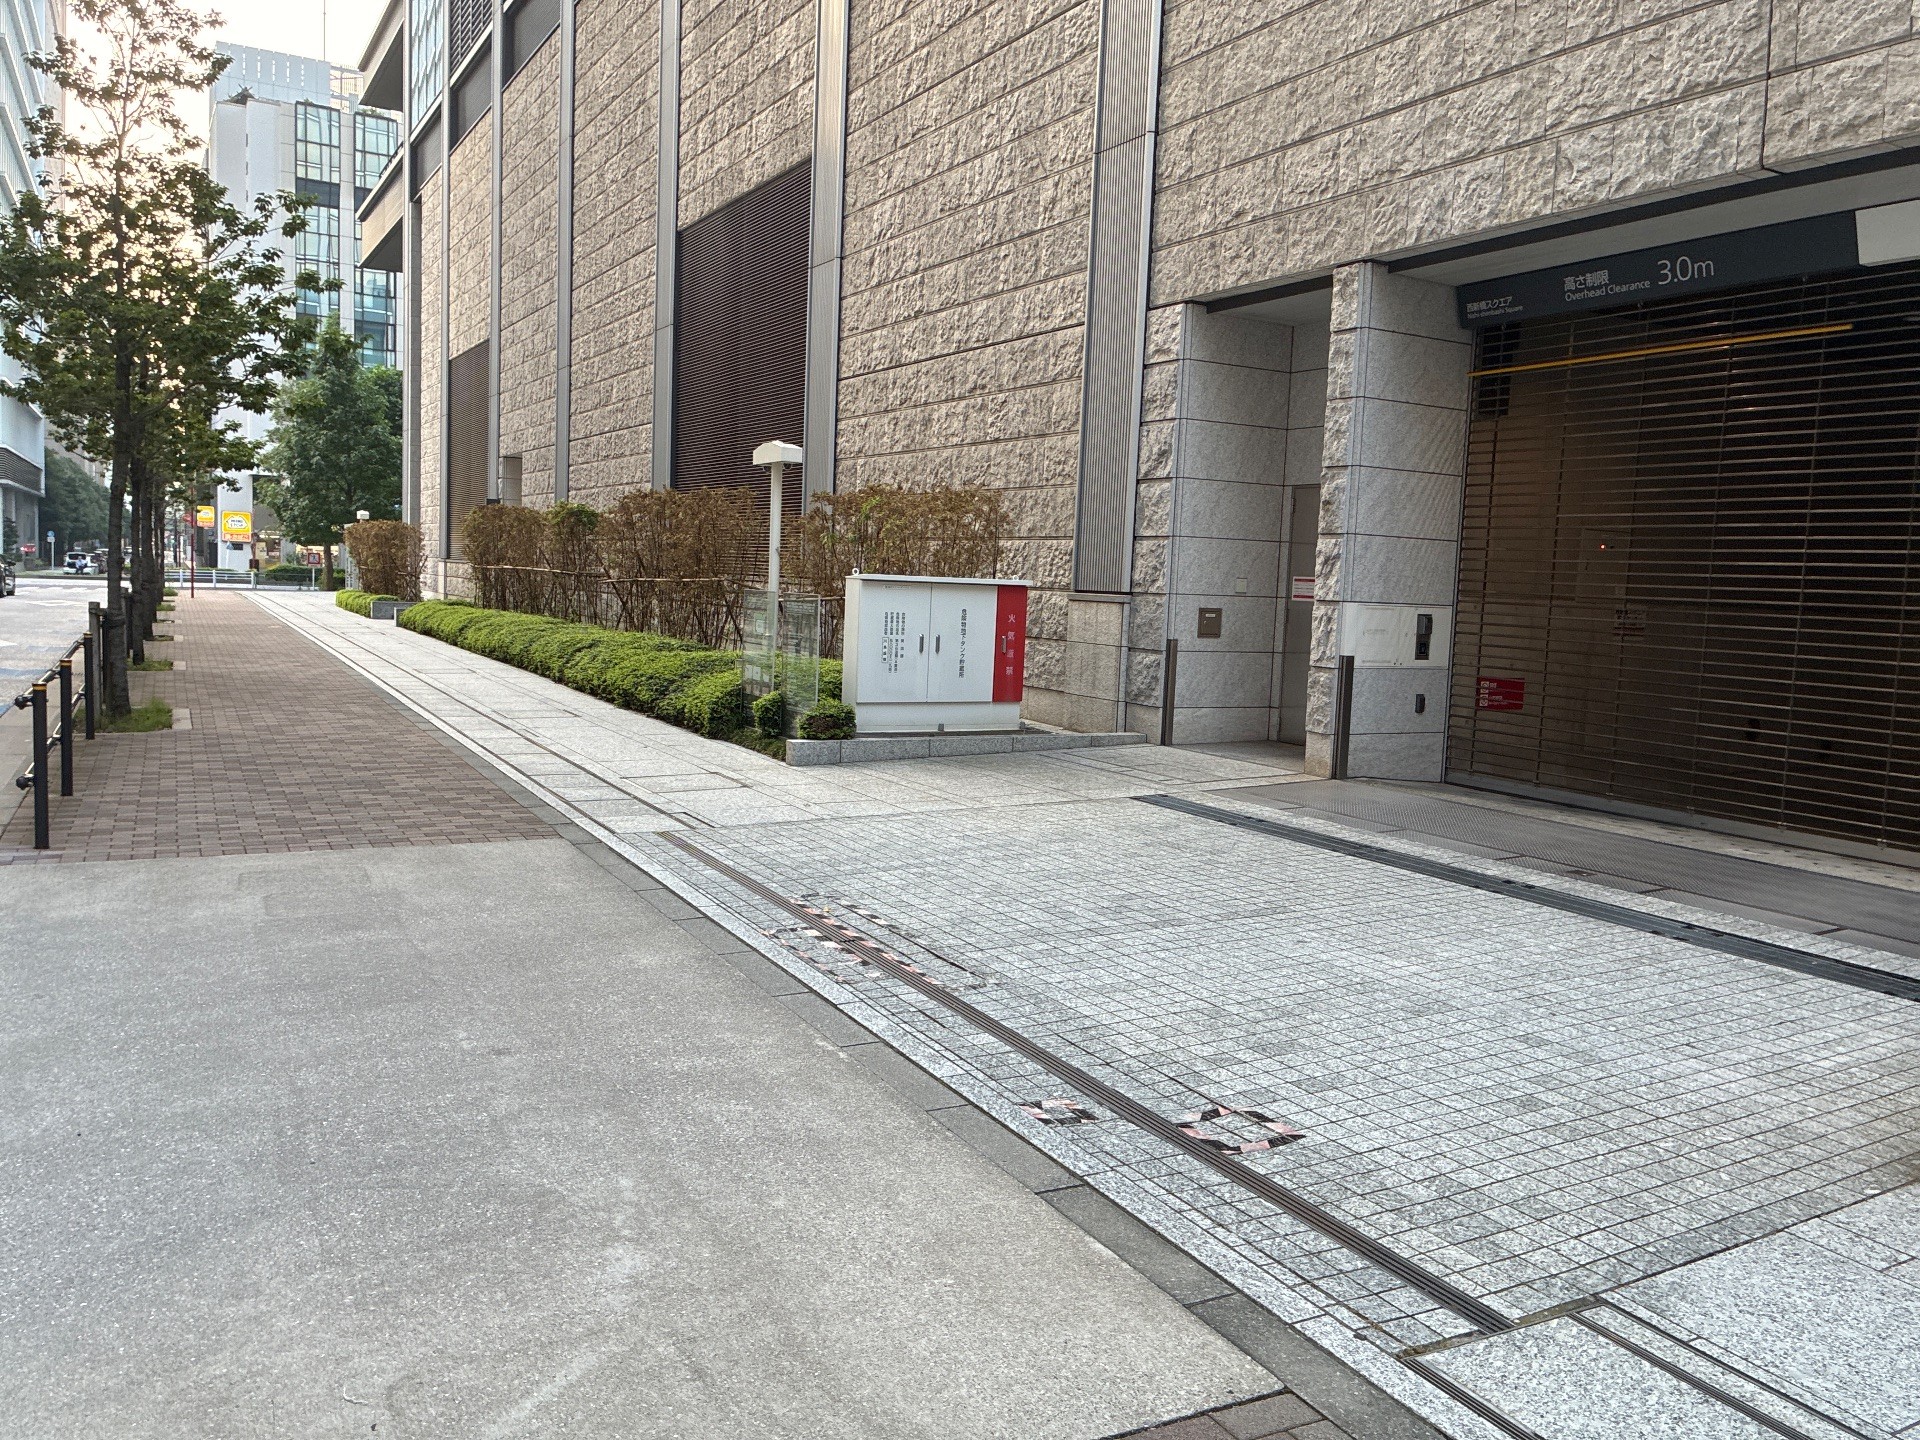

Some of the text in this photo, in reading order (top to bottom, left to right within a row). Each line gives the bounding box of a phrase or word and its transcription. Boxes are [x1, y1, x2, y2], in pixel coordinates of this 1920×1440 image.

[1564, 269, 1609, 291] 高さ制限
[1657, 255, 1715, 285] 3.0m
[1564, 280, 1651, 302] Overhead Clearance
